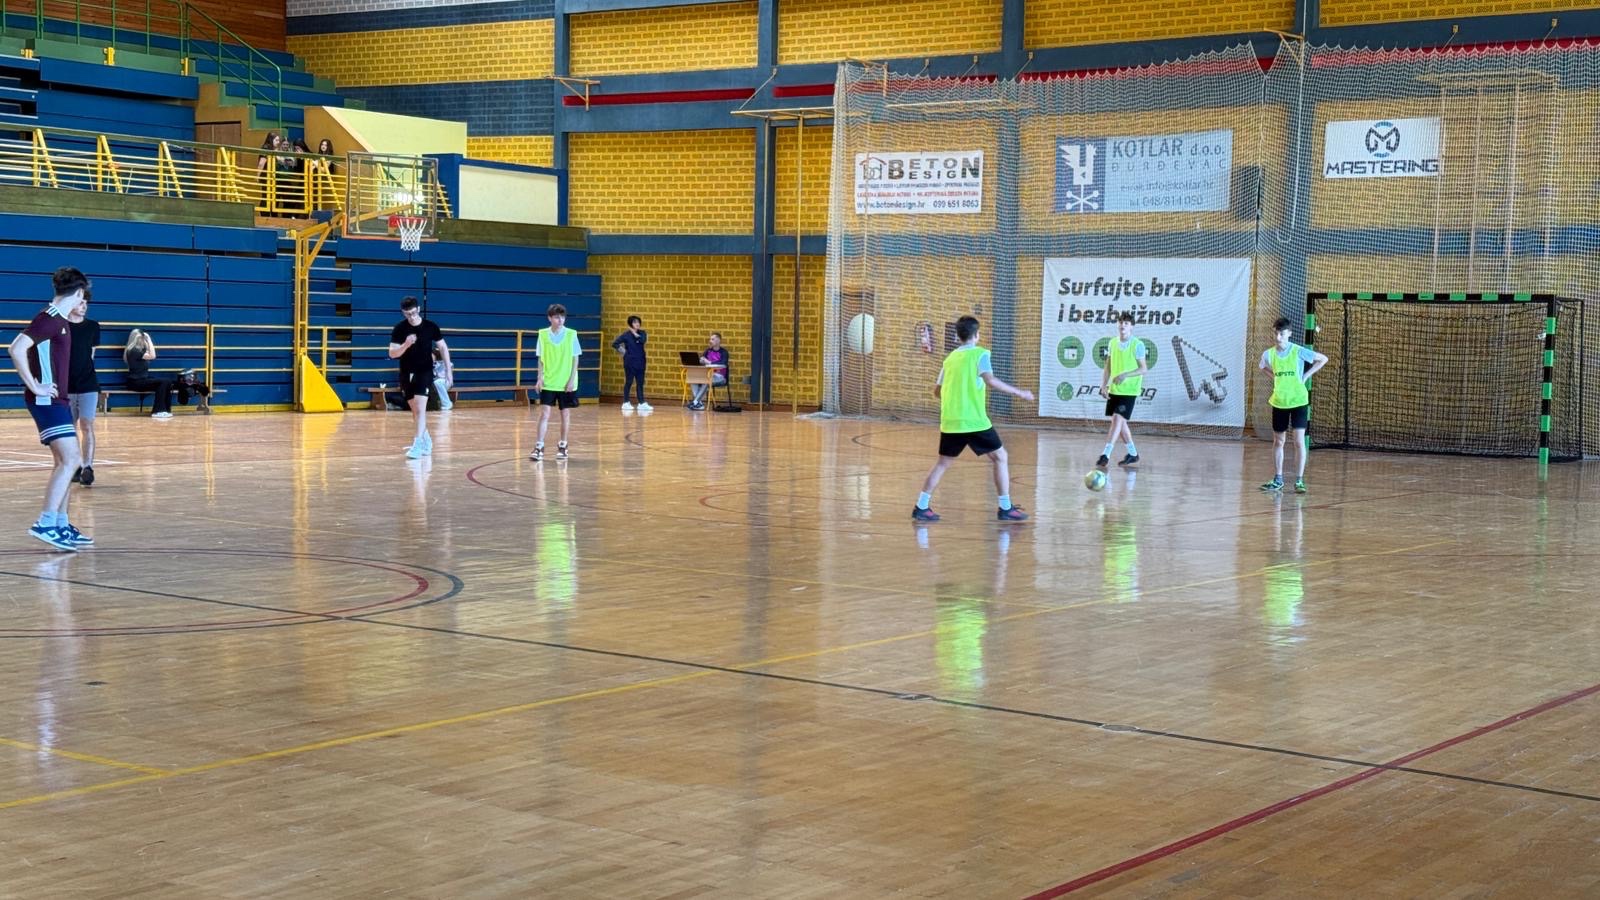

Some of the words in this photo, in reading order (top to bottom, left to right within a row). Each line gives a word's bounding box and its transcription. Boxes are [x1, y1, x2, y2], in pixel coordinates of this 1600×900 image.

[1113, 138, 1183, 158] KOTLAR
[1191, 143, 1225, 156] d.o.o.
[888, 157, 980, 180] BETON
[1326, 159, 1439, 175] MASTERING
[1058, 276, 1145, 301] Surfajte
[1150, 277, 1200, 297] brzo
[1058, 304, 1065, 322] i
